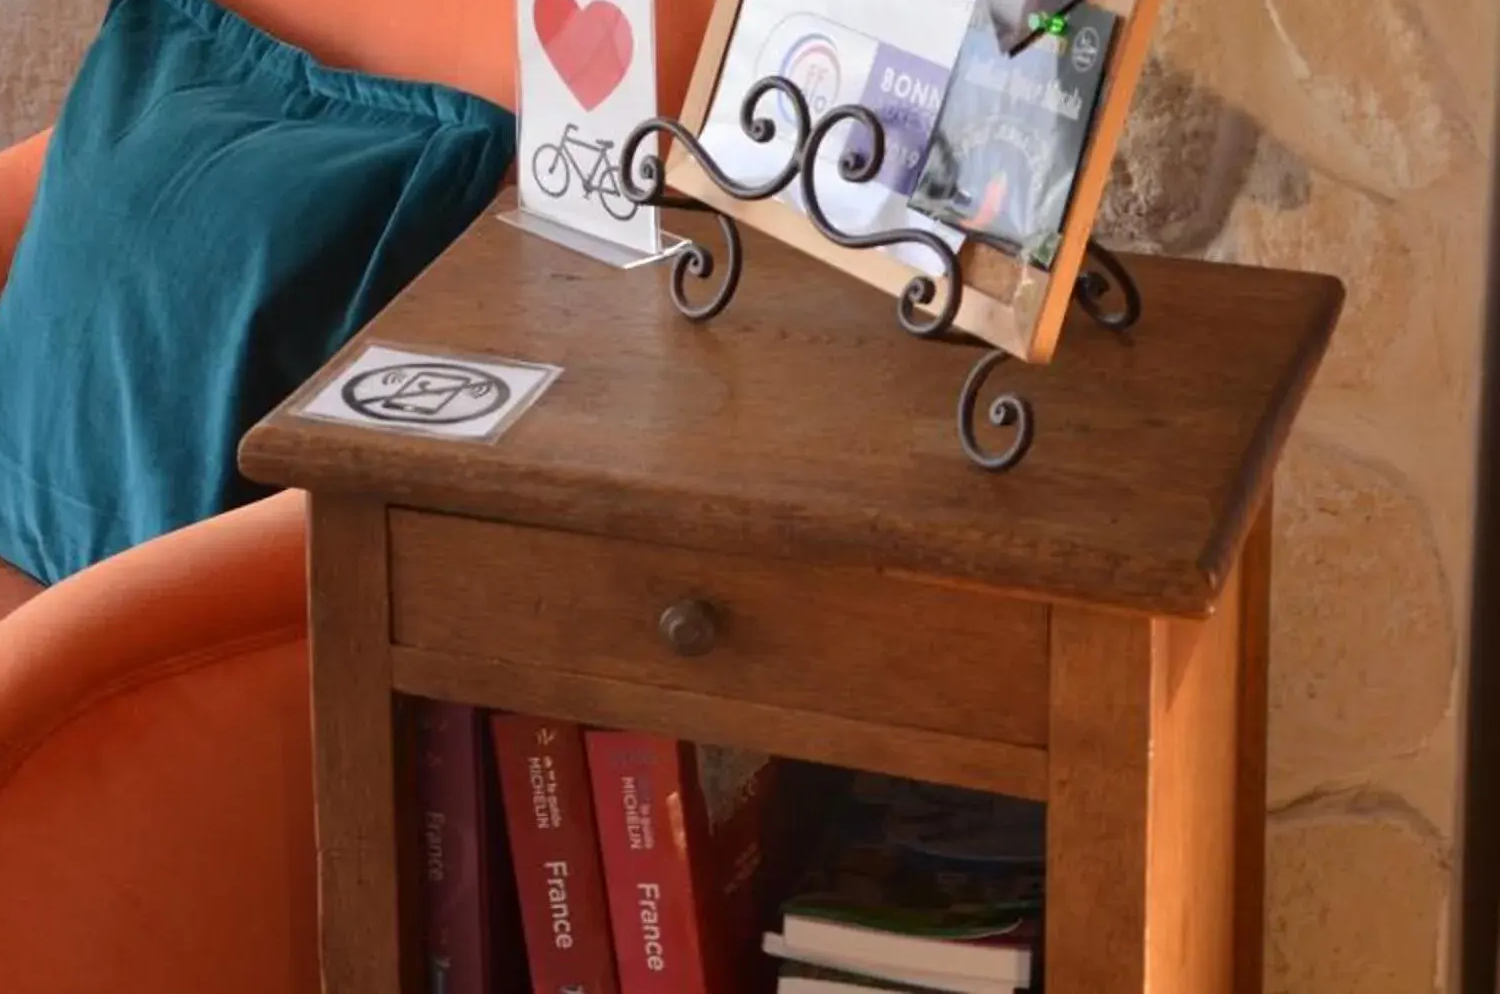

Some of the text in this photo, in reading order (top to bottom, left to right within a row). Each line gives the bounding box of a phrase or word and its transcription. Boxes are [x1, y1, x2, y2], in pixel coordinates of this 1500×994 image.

[529, 757, 550, 829] MICHELIN
[621, 777, 642, 850] MICHELIN
[425, 812, 446, 881] France
[545, 861, 573, 949] France
[637, 883, 664, 971] France
